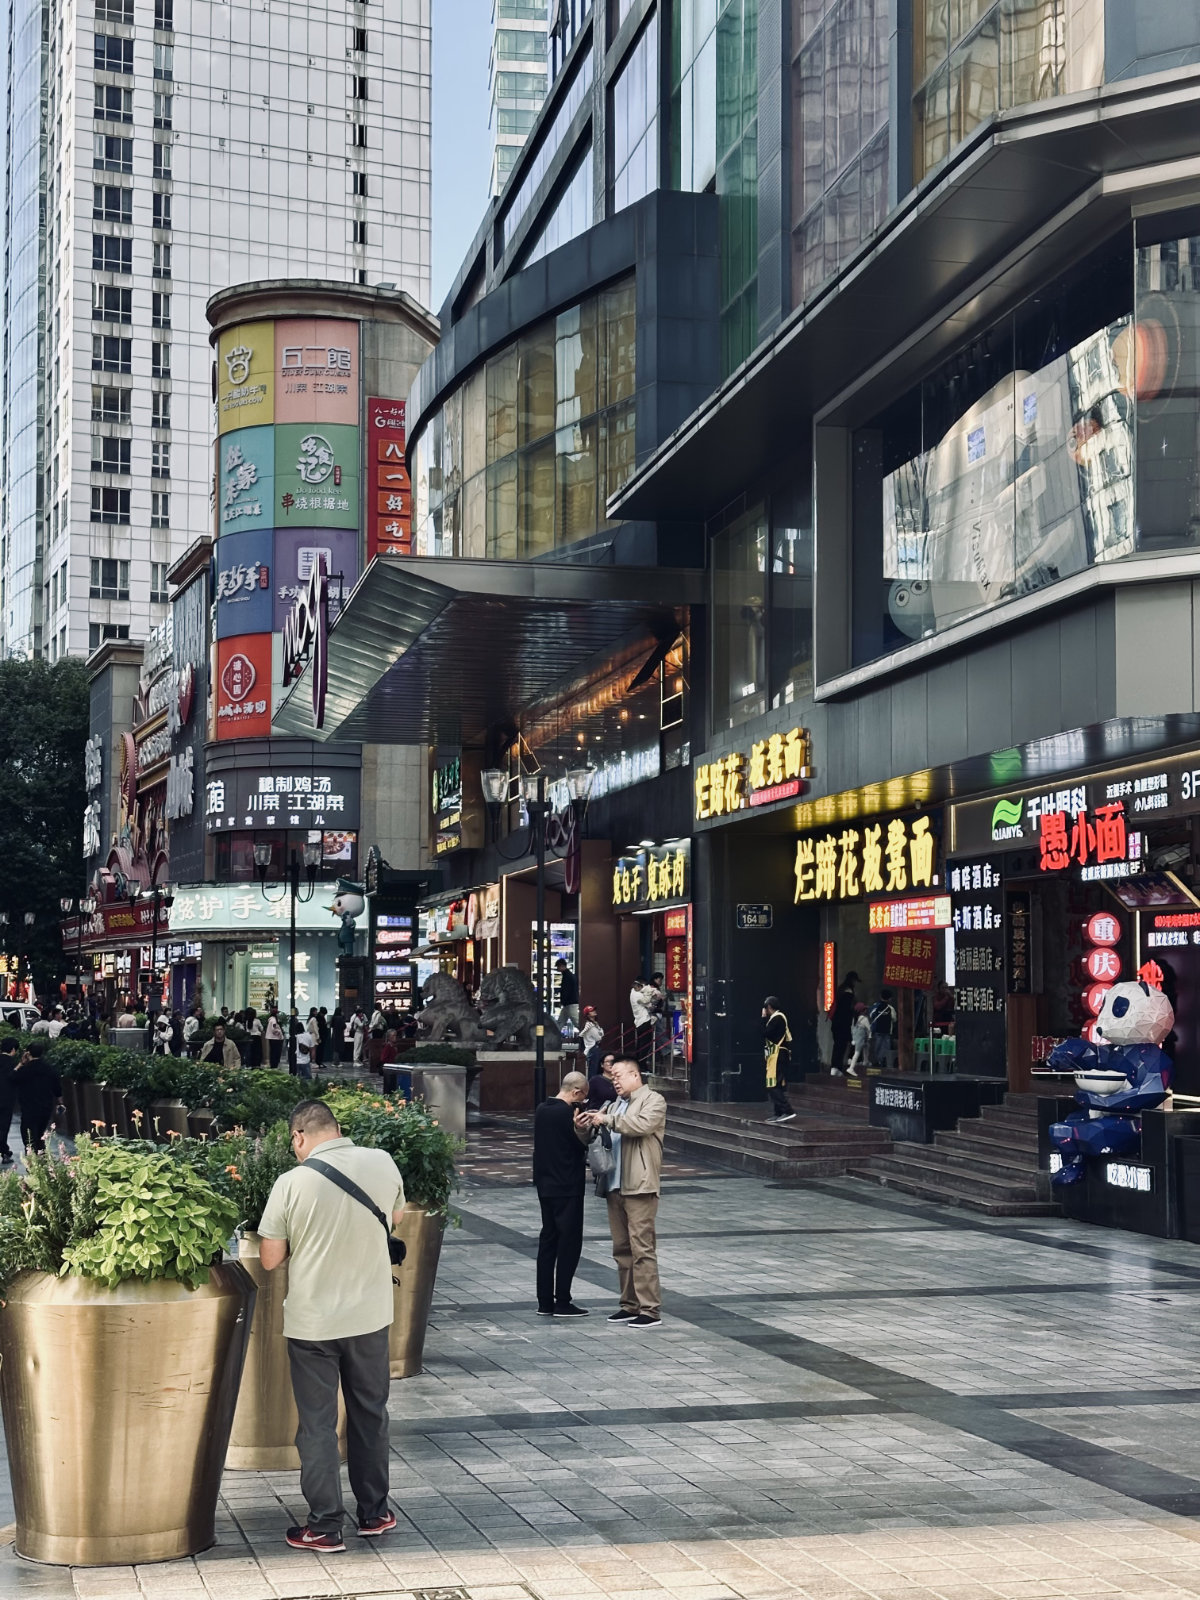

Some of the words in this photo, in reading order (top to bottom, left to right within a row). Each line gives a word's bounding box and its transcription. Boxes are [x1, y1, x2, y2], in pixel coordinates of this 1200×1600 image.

[749, 727, 804, 790] 板凳面
[247, 794, 280, 811] 川菜
[287, 794, 344, 811] 江湖菜
[794, 815, 934, 905] 烂蹄花板凳面
[742, 914, 757, 924] 164
[952, 903, 993, 933] 卡斯酒店
[891, 936, 932, 959] 温馨提示
